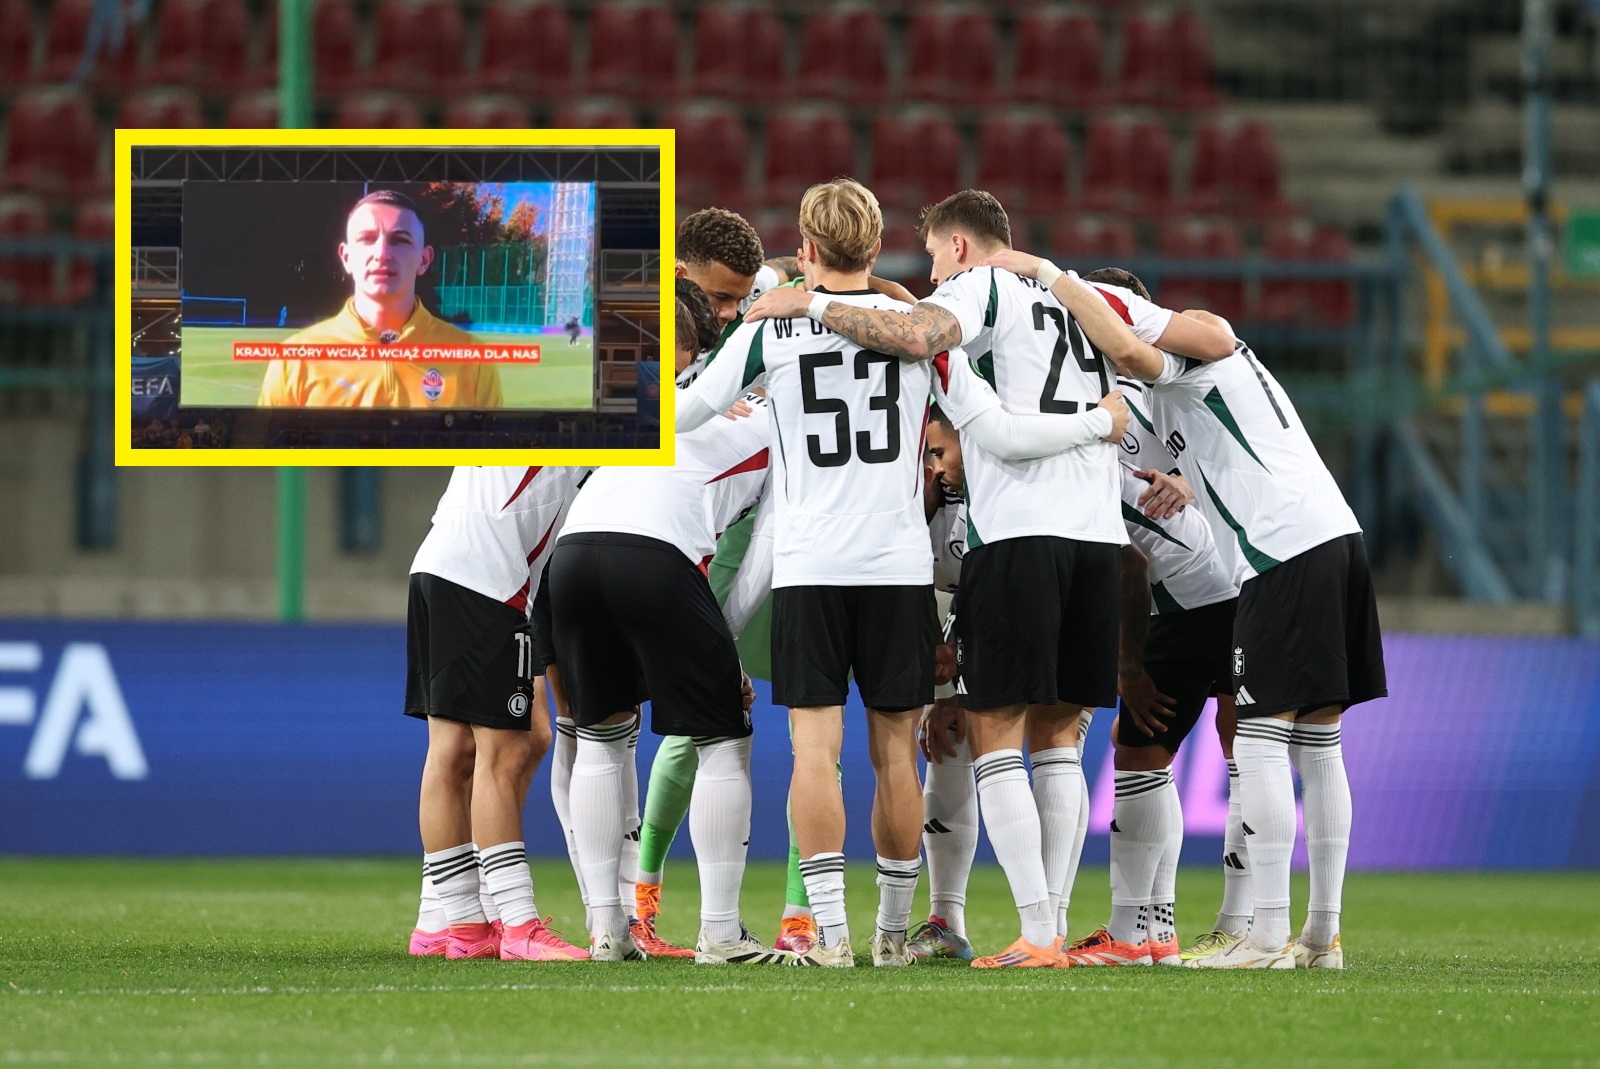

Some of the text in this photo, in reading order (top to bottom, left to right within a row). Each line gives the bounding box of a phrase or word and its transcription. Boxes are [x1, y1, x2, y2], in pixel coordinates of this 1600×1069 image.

[235, 346, 280, 359] KRAJU,
[282, 345, 323, 358] KTÓRY
[325, 346, 368, 361] WCIĄŻ
[377, 346, 420, 361] WCIĄŻ
[422, 348, 481, 360] OTWIERA
[484, 349, 509, 360] DLA
[512, 349, 539, 360] NAS
[131, 375, 174, 396] EFA
[799, 350, 901, 468] 53
[514, 632, 532, 680] 11
